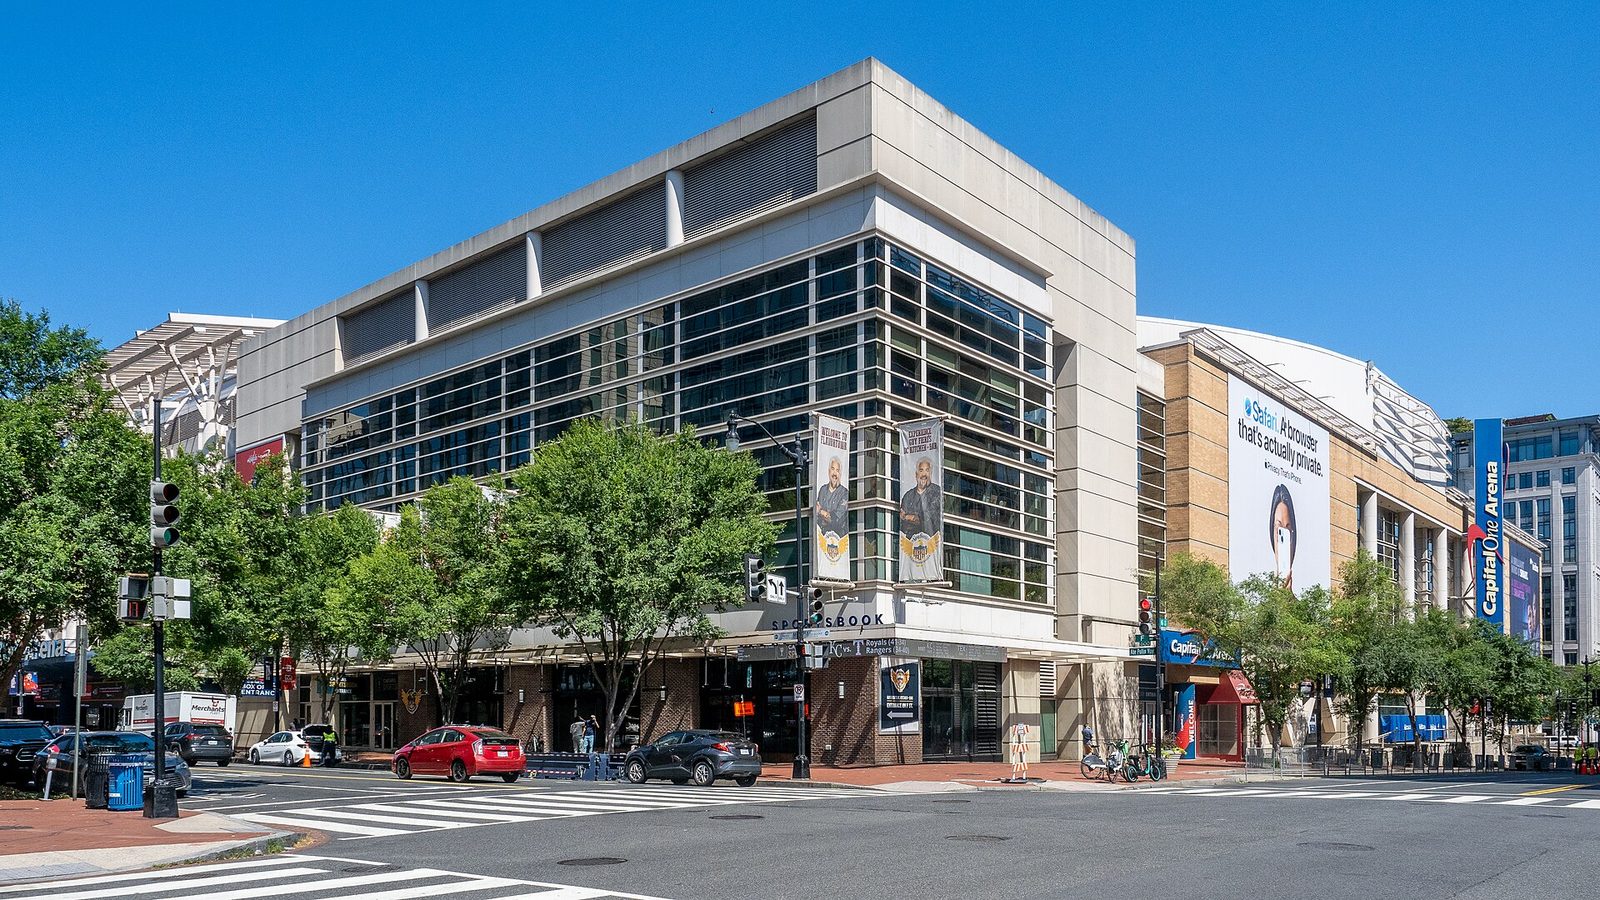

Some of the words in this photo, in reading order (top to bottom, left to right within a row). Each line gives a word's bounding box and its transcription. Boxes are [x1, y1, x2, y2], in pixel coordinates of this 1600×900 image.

[1253, 400, 1279, 433] Safari.
[1280, 417, 1287, 437] A
[1288, 420, 1318, 453] browser
[1238, 418, 1263, 448] that's
[1264, 436, 1295, 467] actually
[1297, 450, 1323, 477] private.
[1485, 461, 1498, 517] Arena
[772, 614, 884, 630] SPORSBOOK
[866, 639, 887, 648] Royals
[866, 647, 892, 656] Rangers
[191, 704, 225, 713] Merchants
